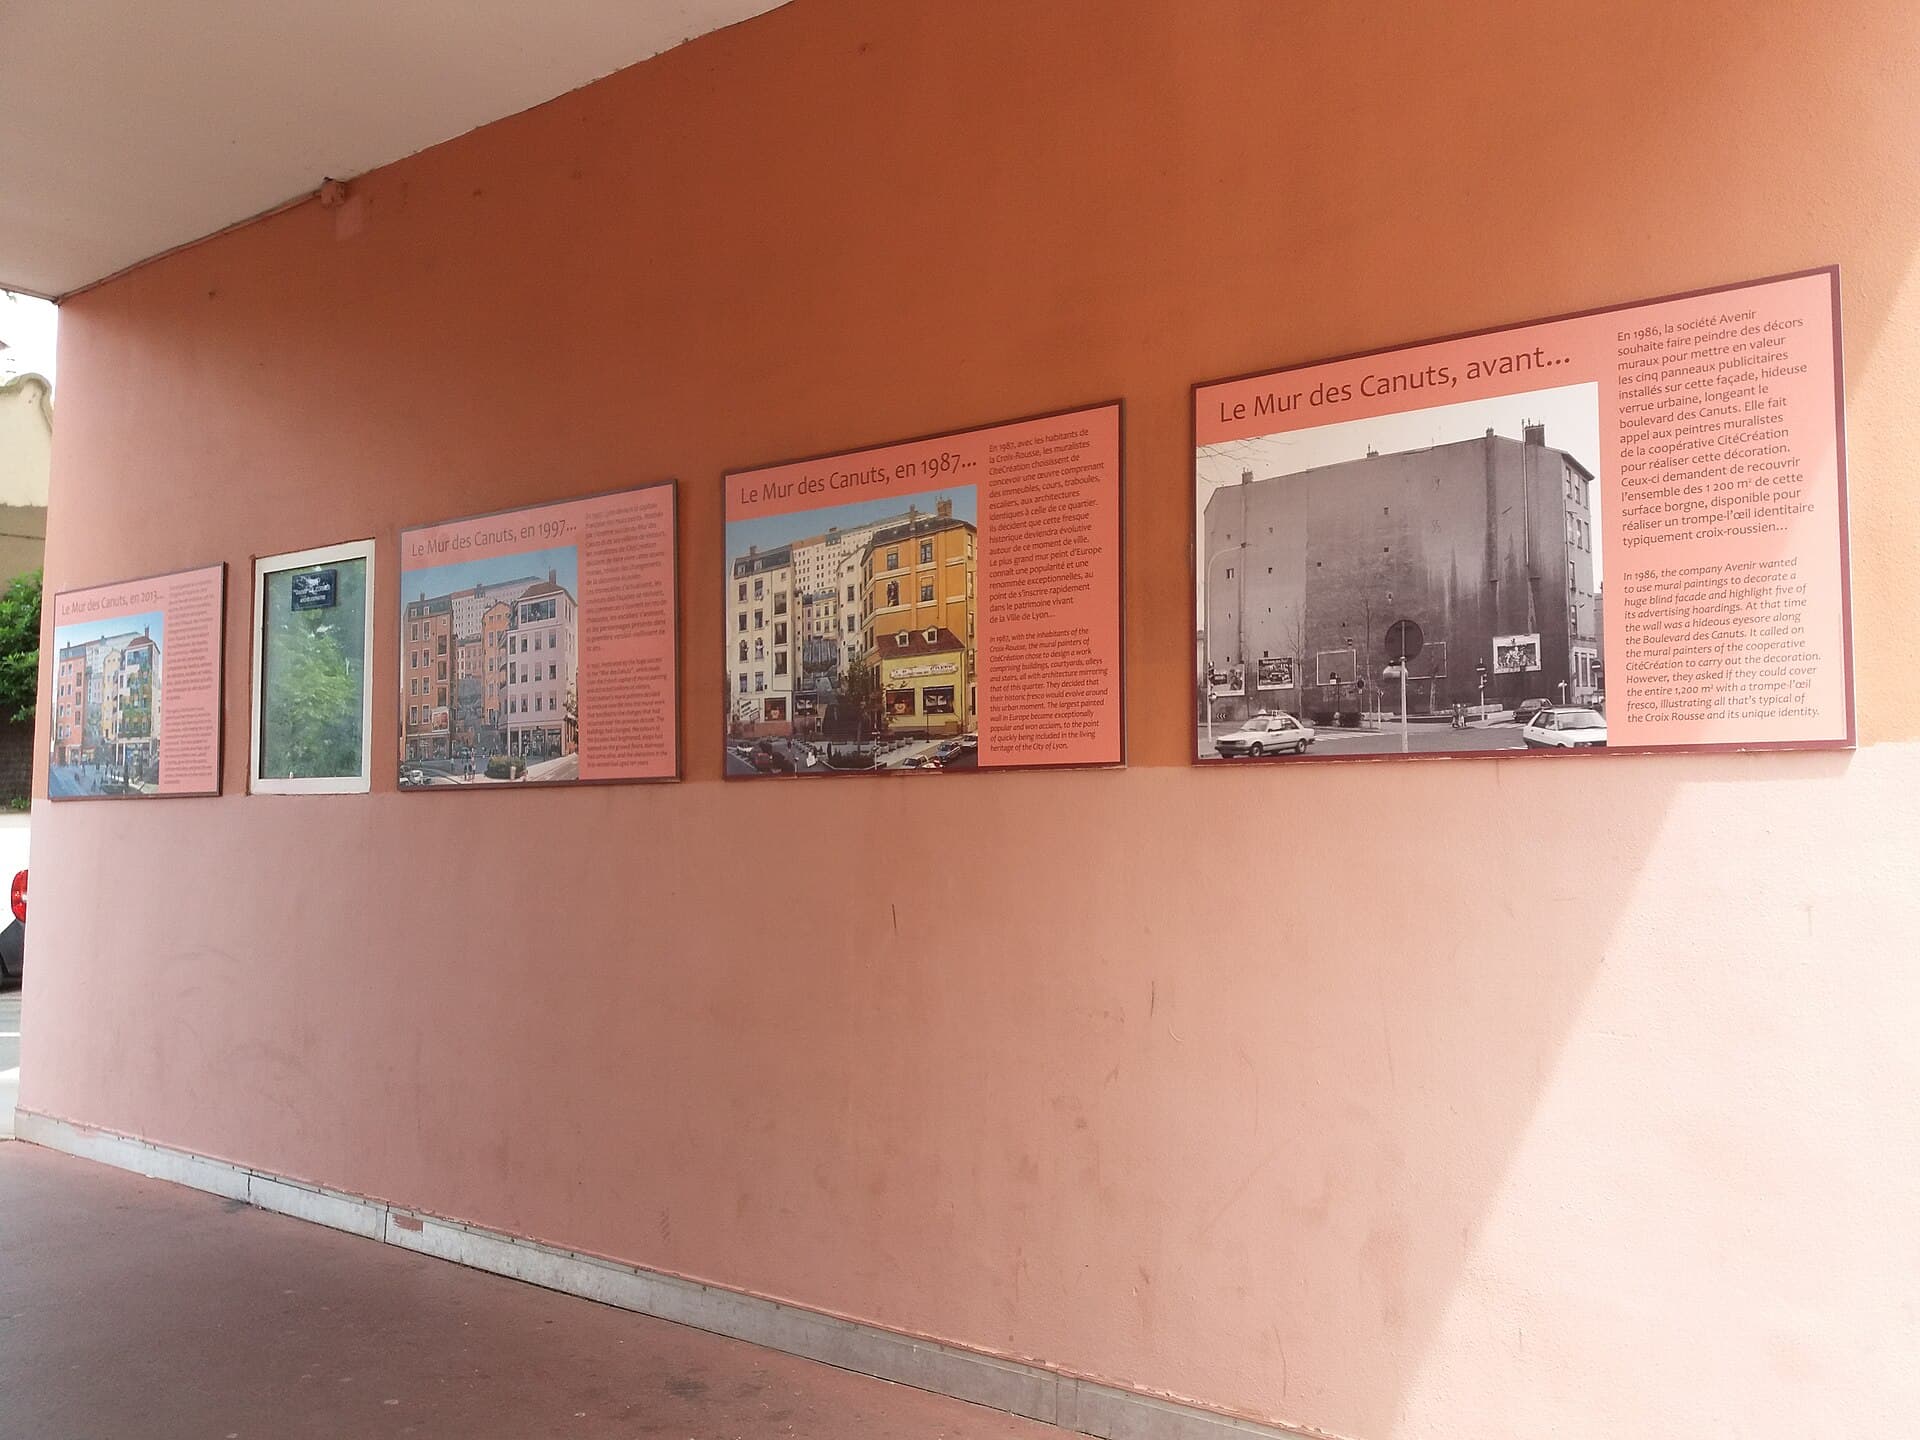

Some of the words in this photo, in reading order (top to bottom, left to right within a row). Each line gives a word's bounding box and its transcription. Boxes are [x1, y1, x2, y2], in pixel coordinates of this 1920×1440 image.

[1618, 332, 1630, 342] En
[1634, 326, 1662, 340] 1986,
[1665, 324, 1674, 334] la
[1677, 317, 1716, 332] société
[1719, 310, 1755, 324] Avenir
[1618, 341, 1664, 356] souhaite
[1667, 337, 1691, 348] faire
[1694, 329, 1737, 346] peindre
[1740, 325, 1760, 336] des
[1763, 320, 1803, 332] décors
[1618, 358, 1659, 371] muraux
[1662, 352, 1688, 367] pour
[1691, 346, 1729, 359] mettre
[1732, 343, 1746, 352] en
[1749, 337, 1785, 349] valeur
[1619, 375, 1633, 385] les
[1635, 372, 1658, 382] cinq
[1661, 364, 1715, 382] panneaux
[1719, 352, 1788, 372] publicitaires
[1221, 402, 1245, 423] Le
[1254, 393, 1302, 417] Mur
[1310, 382, 1351, 406] des
[1360, 366, 1457, 397] Canuts,
[1619, 385, 1662, 400] installés
[1665, 383, 1682, 393] sur
[1685, 379, 1713, 389] cette
[1717, 371, 1758, 386] façade,
[1761, 364, 1807, 378] hideuse
[1619, 402, 1654, 414] verrue
[1657, 396, 1702, 409] urbaine,
[1705, 386, 1755, 402] longeant
[1759, 384, 1768, 394] le
[1619, 412, 1674, 429] boulevard
[1677, 410, 1696, 421] des
[1699, 405, 1741, 417] Canuts.
[1745, 400, 1764, 411] Elle
[1768, 398, 1786, 407] fait
[1620, 430, 1649, 445] appel
[1652, 430, 1672, 439] aux
[1675, 423, 1721, 439] peintres
[1724, 414, 1783, 429] muralistes
[1621, 448, 1634, 458] de
[1636, 446, 1645, 456] la
[1648, 438, 1714, 455] coopérative
[1718, 429, 1788, 445] CitéCréation
[1621, 462, 1647, 476] pour
[1649, 457, 1689, 469] réaliser
[1692, 453, 1721, 463] cette
[1724, 444, 1790, 459] décoration.
[1621, 473, 1660, 487] Ceux-ci
[1662, 467, 1727, 482] demandent
[1730, 464, 1744, 474] de
[1747, 457, 1800, 472] recouvrir
[741, 488, 758, 504] Le
[763, 482, 794, 501] Mur
[798, 476, 825, 495] des
[830, 467, 890, 489] Canuts,
[895, 464, 915, 479] en
[1683, 484, 1703, 495] des
[1755, 476, 1769, 486] de
[1772, 474, 1803, 484] cette
[1622, 504, 1662, 517] surface
[1664, 500, 1708, 513] borgne,
[1710, 491, 1770, 508] disponible
[1773, 490, 1801, 503] pour
[1622, 520, 1662, 531] réaliser
[1665, 518, 1678, 527] un
[1754, 503, 1814, 517] identitaire
[412, 544, 424, 557] Le
[427, 538, 450, 554] Mur
[452, 535, 471, 550] des
[475, 528, 517, 546] Canuts,
[520, 527, 535, 539] en
[1623, 531, 1693, 549] typiquement
